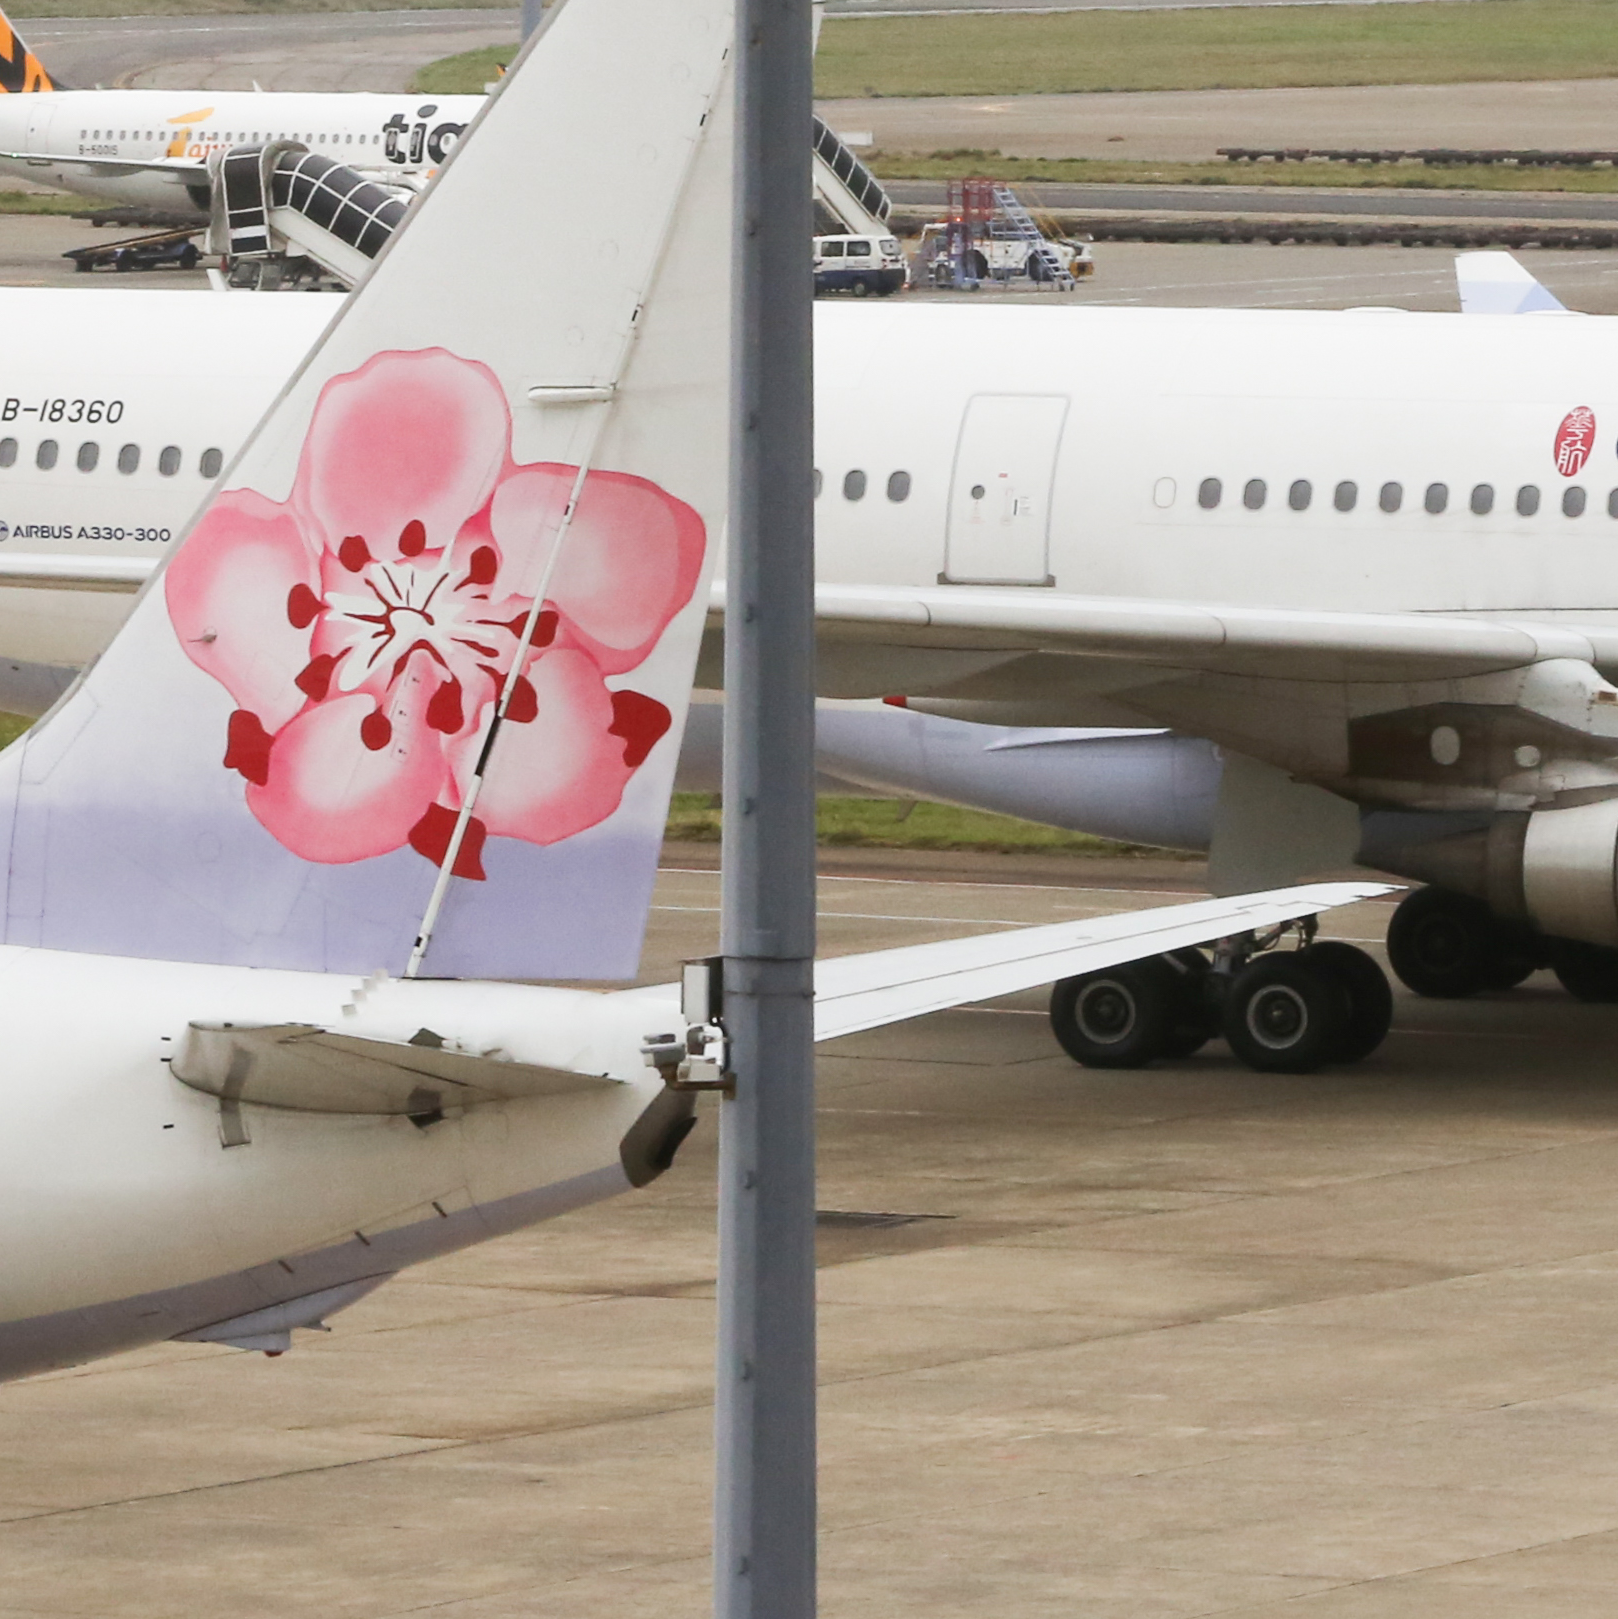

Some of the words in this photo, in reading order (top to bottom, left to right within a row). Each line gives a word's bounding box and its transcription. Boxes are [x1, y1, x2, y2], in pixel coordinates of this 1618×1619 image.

[1, 397, 124, 424] B-18360
[13, 525, 73, 540] AIRBUS
[77, 526, 172, 542] A330-300
